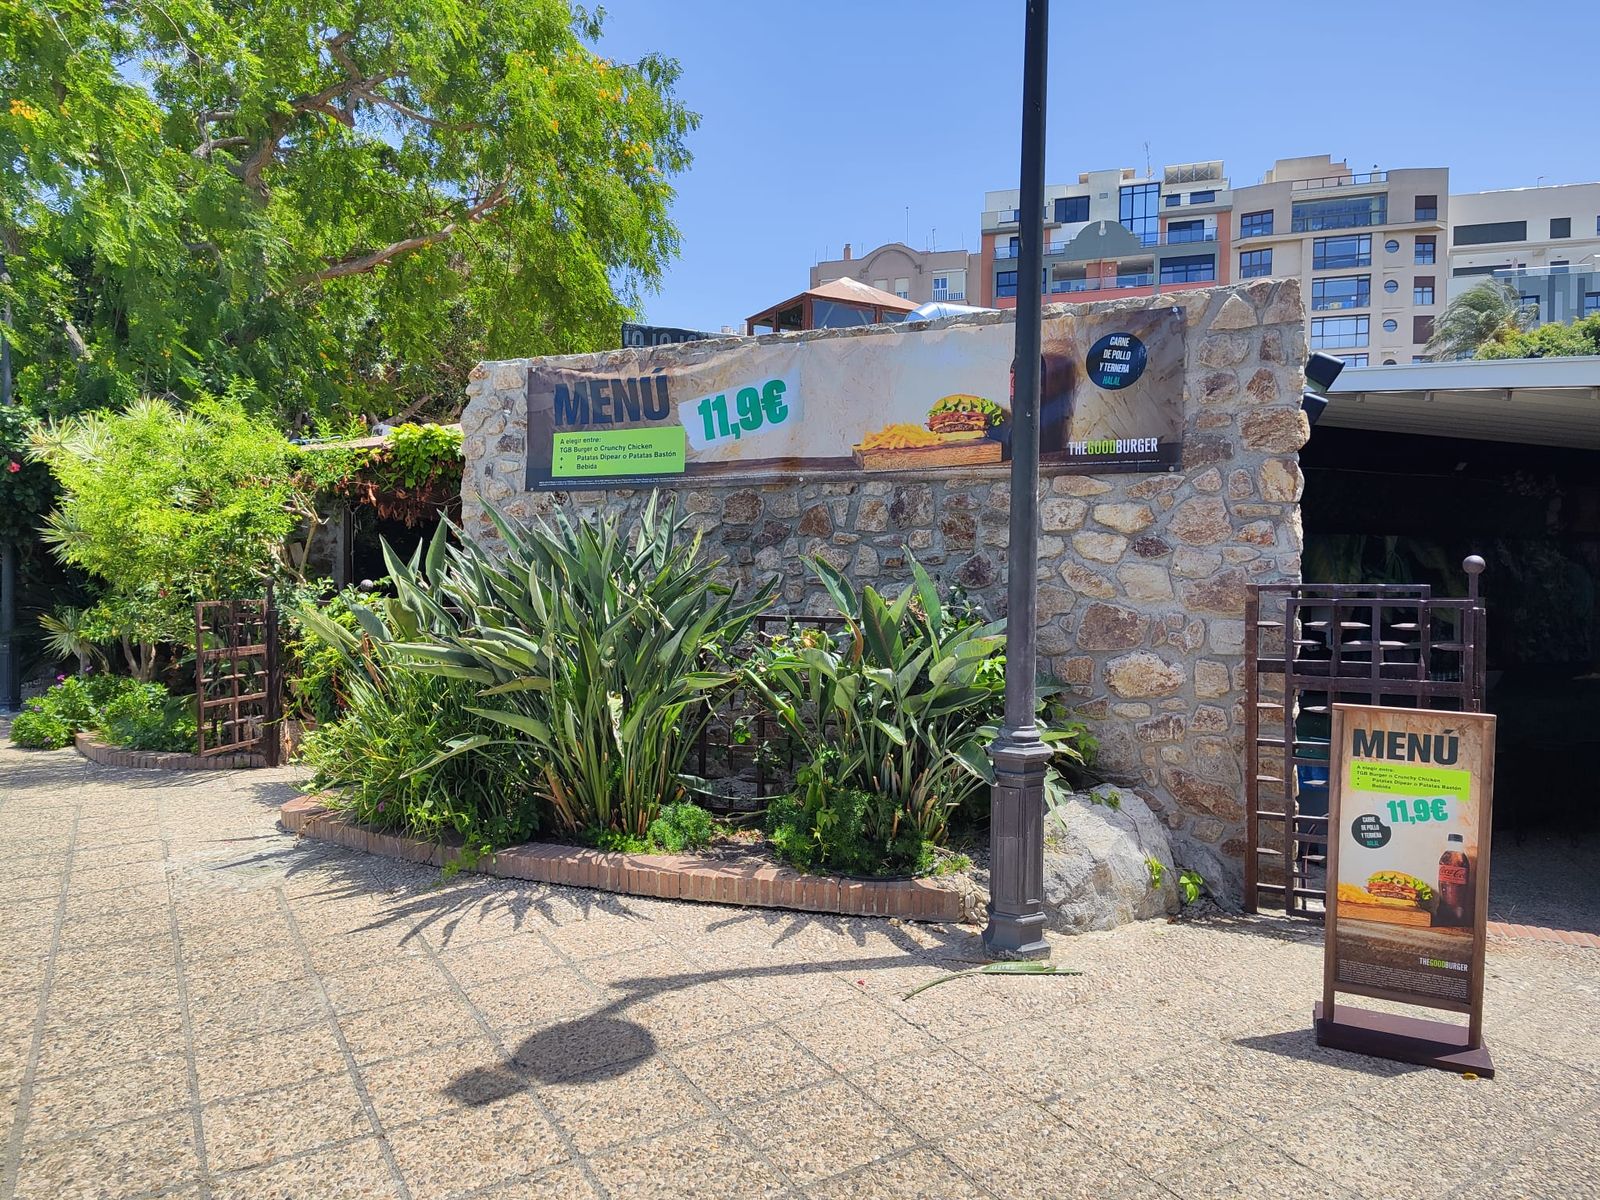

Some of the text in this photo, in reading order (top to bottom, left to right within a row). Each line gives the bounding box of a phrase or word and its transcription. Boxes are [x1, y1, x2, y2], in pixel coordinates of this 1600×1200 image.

[1109, 336, 1131, 347] CARNE
[1103, 349, 1131, 360] DE POLLO
[1100, 362, 1130, 374] Y TERNERA
[1102, 376, 1120, 386] HALAL
[553, 367, 670, 427] MENÚ
[697, 378, 790, 441] 11,9€
[600, 444, 626, 452] Crunchy
[600, 452, 621, 461] Dipear
[1352, 729, 1458, 765] MENÚ
[1386, 798, 1449, 825] 11,9€
